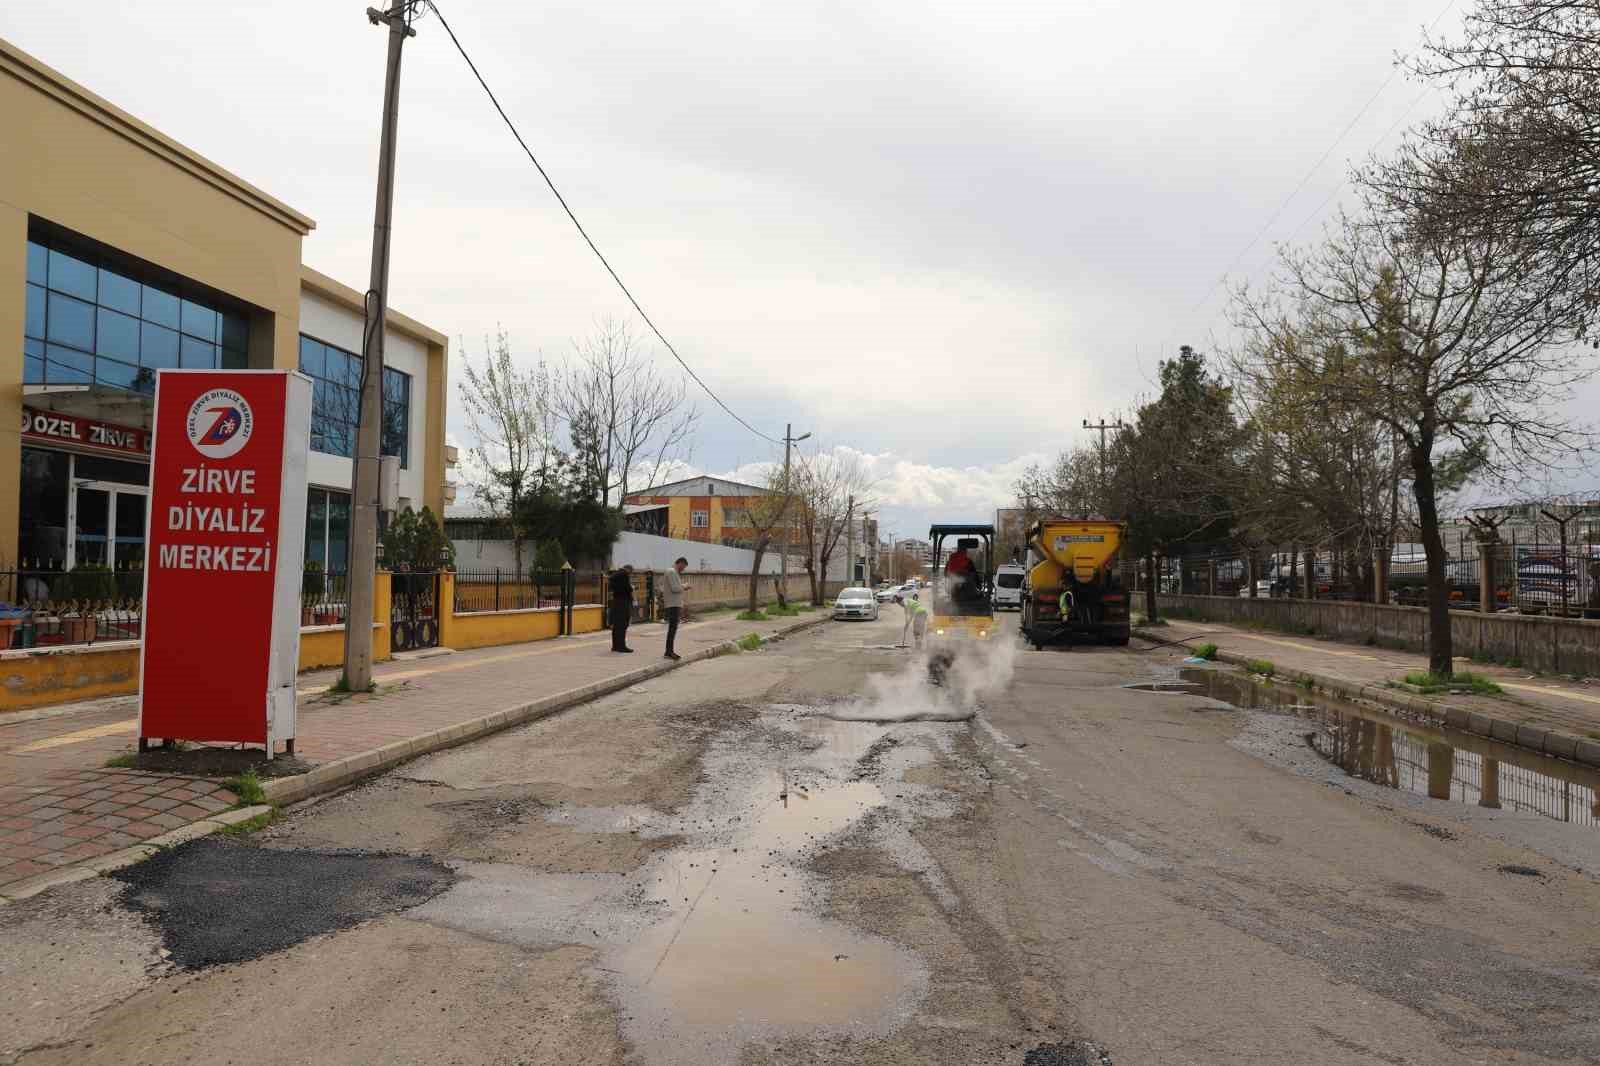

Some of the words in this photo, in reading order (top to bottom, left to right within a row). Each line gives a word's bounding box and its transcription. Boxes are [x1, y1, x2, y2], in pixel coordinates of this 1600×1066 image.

[89, 423, 136, 449] ZİRVE
[181, 463, 256, 494] ZİRVE
[168, 500, 265, 533] DİYALİZ
[159, 541, 271, 572] MERKEZİ
